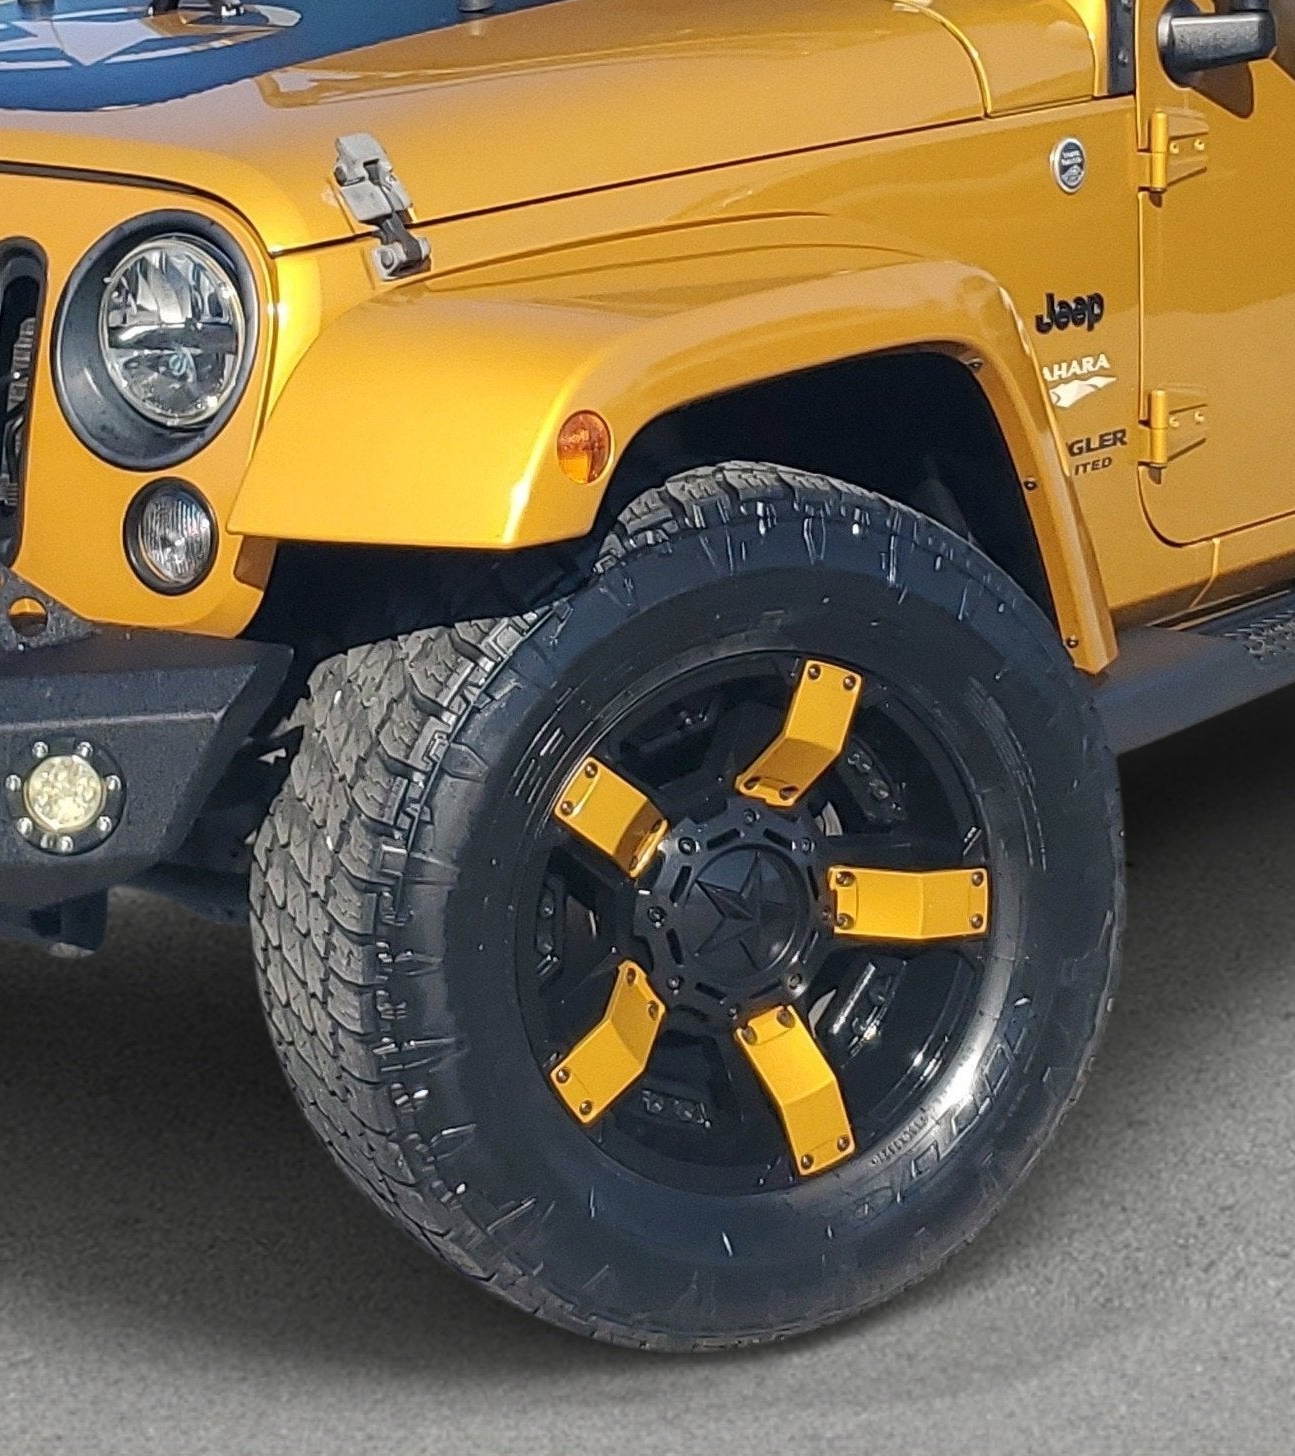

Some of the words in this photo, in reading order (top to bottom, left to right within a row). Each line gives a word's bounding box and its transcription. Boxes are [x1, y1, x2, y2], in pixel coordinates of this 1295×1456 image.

[1034, 292, 1105, 335] Jeep
[1042, 352, 1111, 382] AHARA
[1066, 428, 1128, 458] GLER
